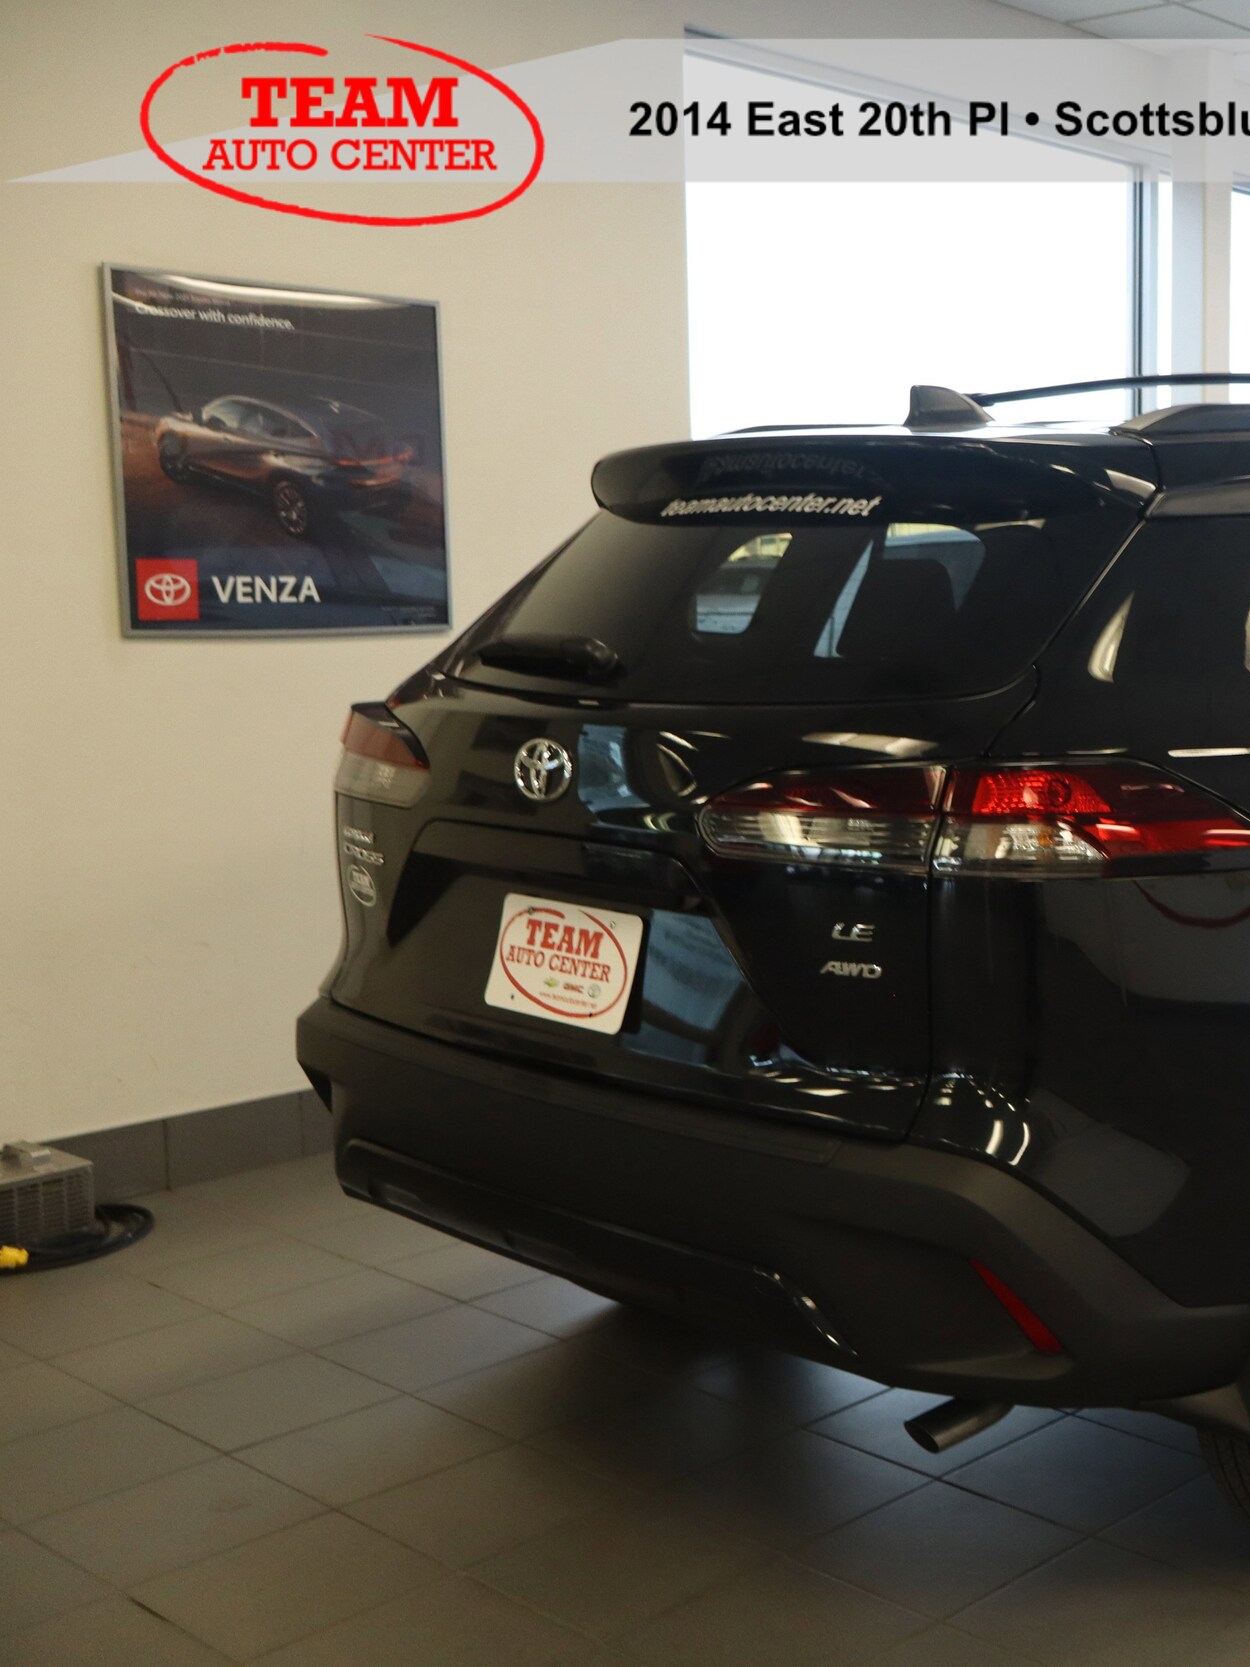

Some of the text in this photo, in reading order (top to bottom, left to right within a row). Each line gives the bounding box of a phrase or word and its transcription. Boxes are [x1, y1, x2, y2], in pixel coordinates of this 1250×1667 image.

[135, 303, 198, 321] Crossover
[199, 308, 226, 323] with
[660, 492, 882, 518] teamautocenter.net
[211, 574, 321, 604] VENZA
[526, 919, 604, 958] TEAM
[831, 922, 876, 942] LE
[507, 946, 611, 982] AUTO CENTER
[820, 960, 883, 979] AWD
